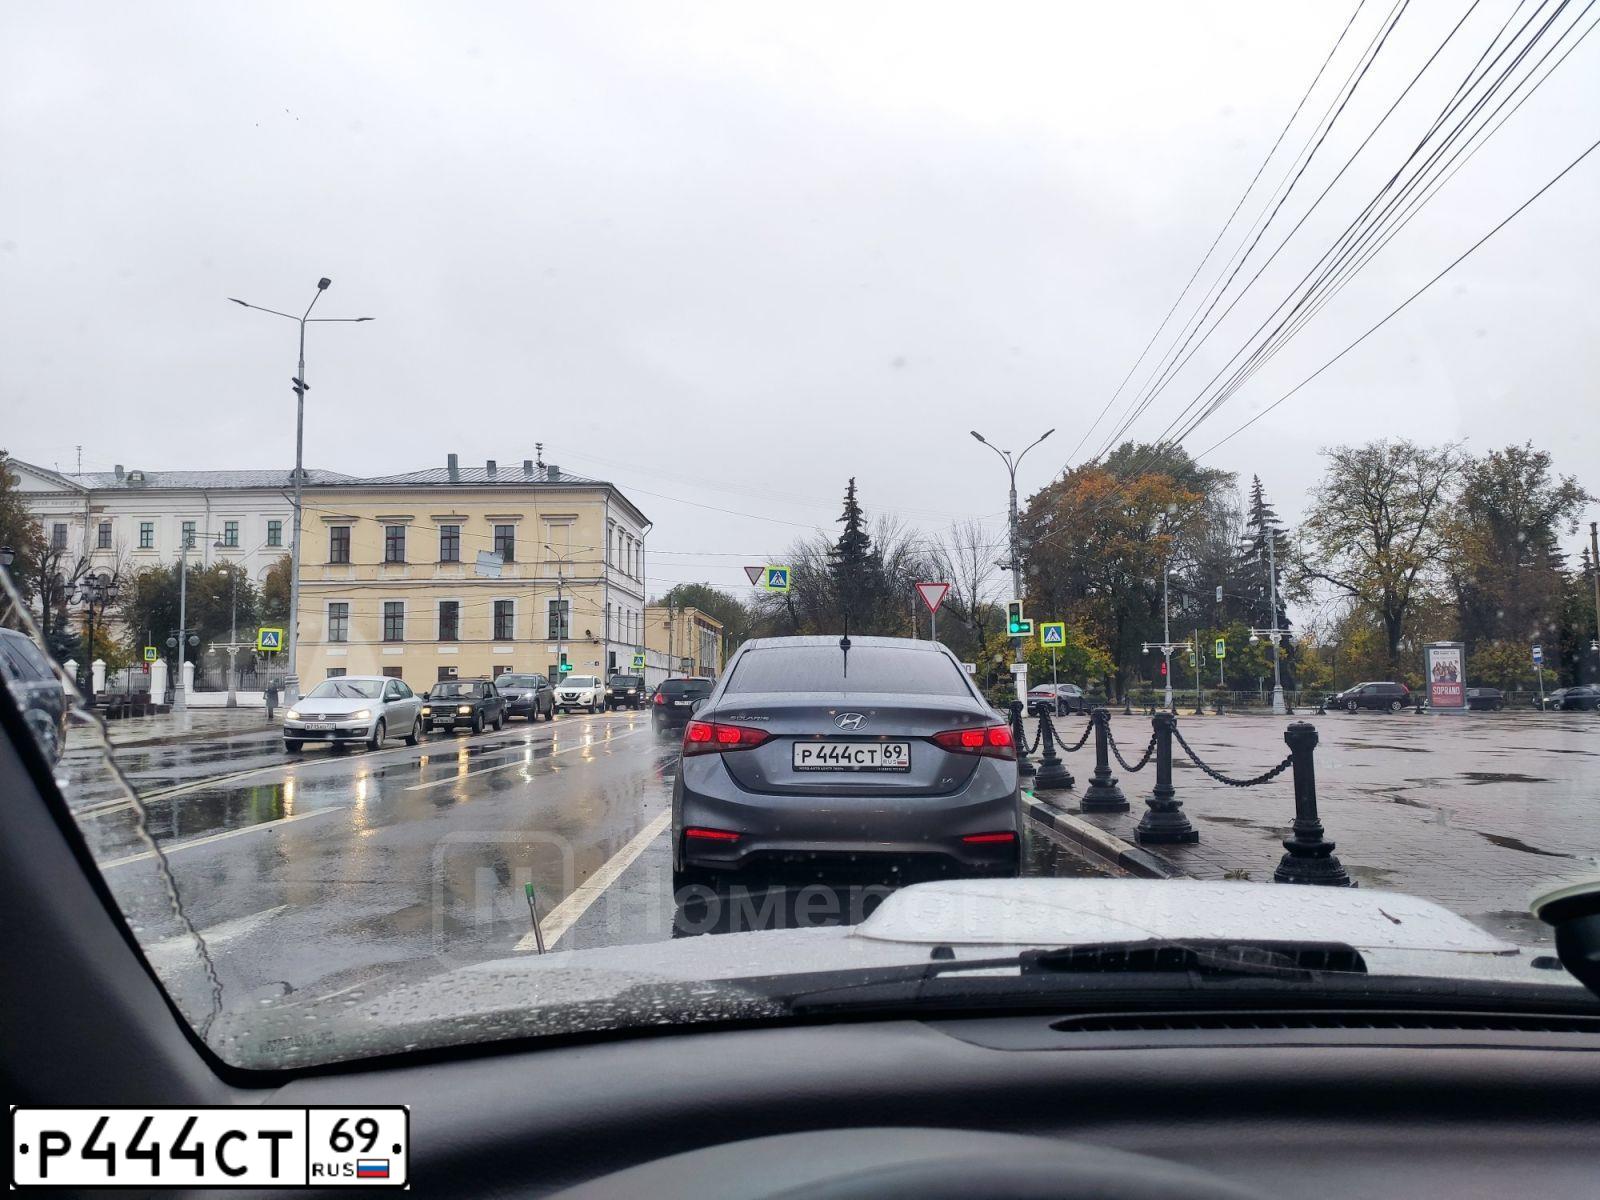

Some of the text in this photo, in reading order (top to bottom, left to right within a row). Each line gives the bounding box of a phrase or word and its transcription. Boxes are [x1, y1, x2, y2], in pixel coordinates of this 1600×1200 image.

[1432, 686, 1460, 695] SOPRANO
[801, 745, 903, 764] Р444СТ 69
